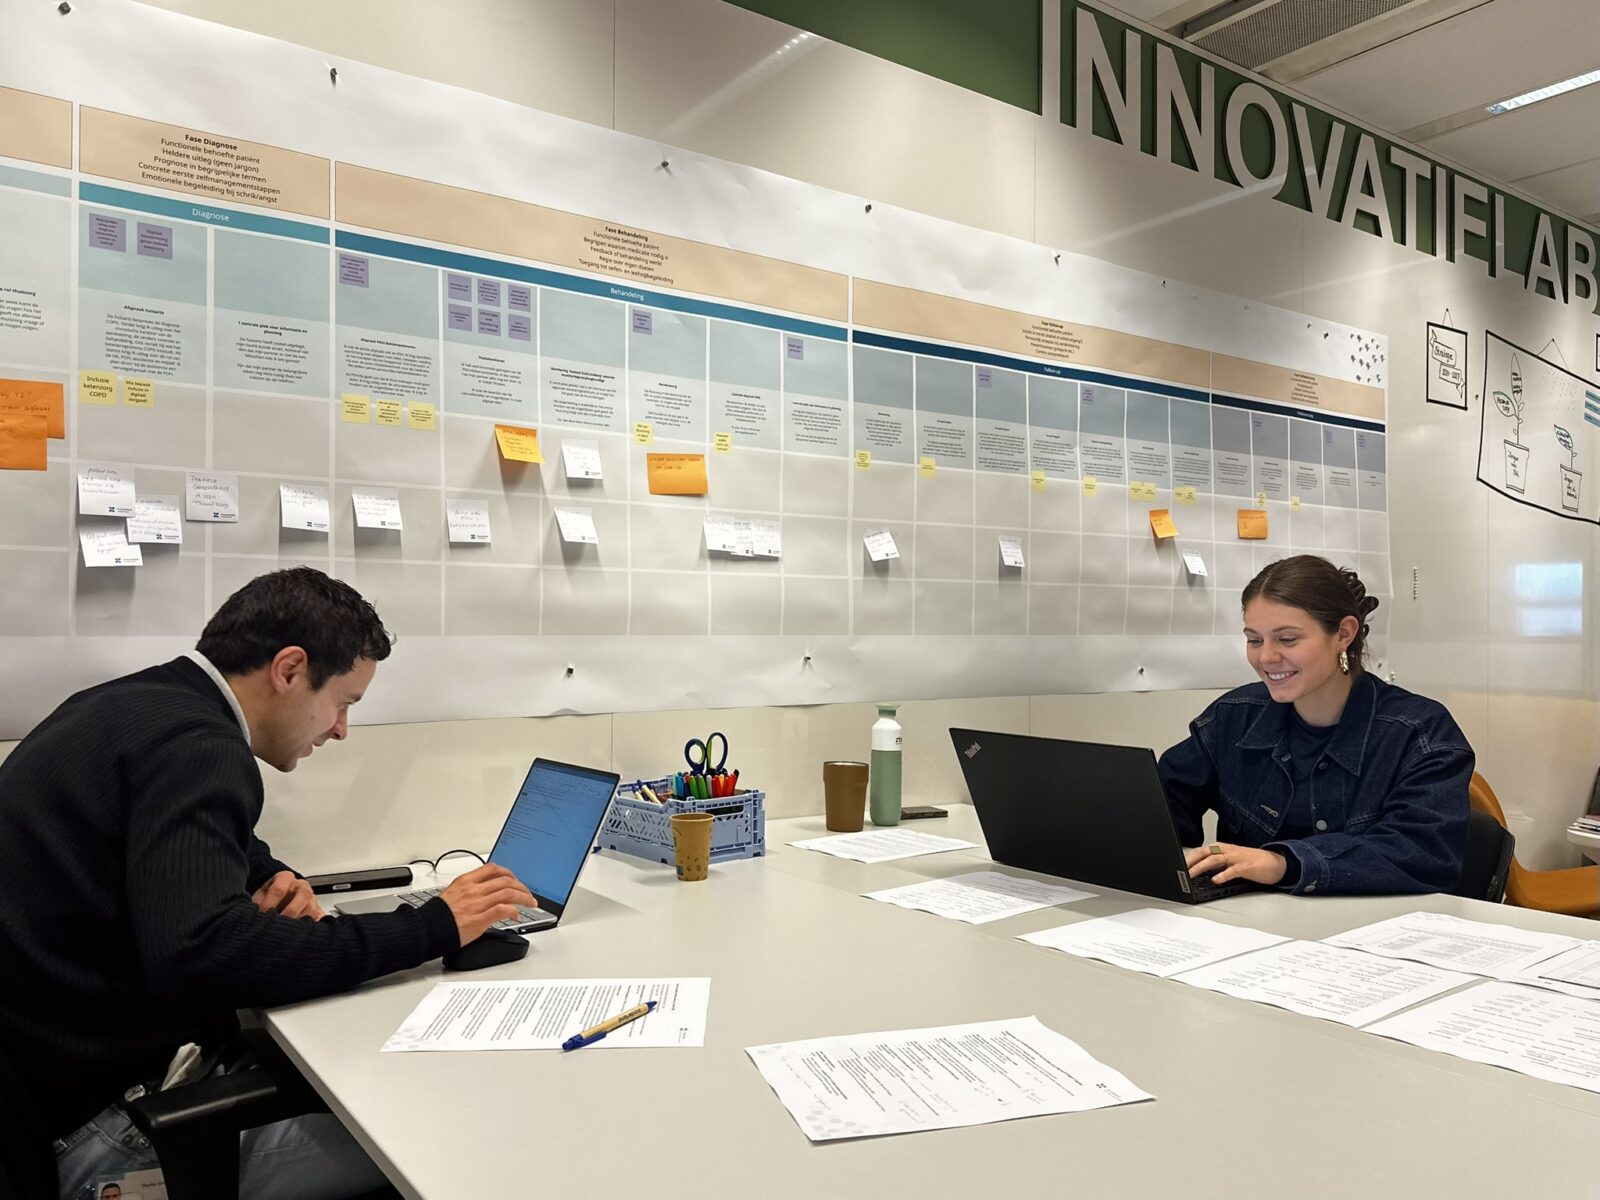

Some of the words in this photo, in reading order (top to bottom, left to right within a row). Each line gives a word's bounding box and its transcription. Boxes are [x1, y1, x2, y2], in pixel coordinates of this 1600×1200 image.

[161, 138, 202, 152] Functionele
[203, 147, 235, 159] behoefte
[185, 134, 202, 143] Fase
[203, 138, 238, 150] Diagnose
[154, 156, 188, 168] Prognose
[198, 164, 240, 178] begrijpelijke
[241, 173, 267, 183] termen
[162, 148, 190, 159] Heldere
[192, 154, 212, 165] uitleg
[213, 158, 233, 167] (geen
[234, 162, 259, 174] jargon)
[138, 162, 171, 174] Concrete
[172, 170, 194, 178] eerste
[196, 174, 281, 195] zelfmanagementstappen
[141, 172, 182, 186] Emotionele
[184, 180, 225, 195] begeleiding
[226, 188, 235, 197] bij
[236, 192, 278, 204] schrik/angst
[192, 208, 230, 222] Diagnose
[618, 229, 648, 242] Behandeling
[610, 287, 644, 302] Behandeling
[84, 383, 113, 392] ketenzorg
